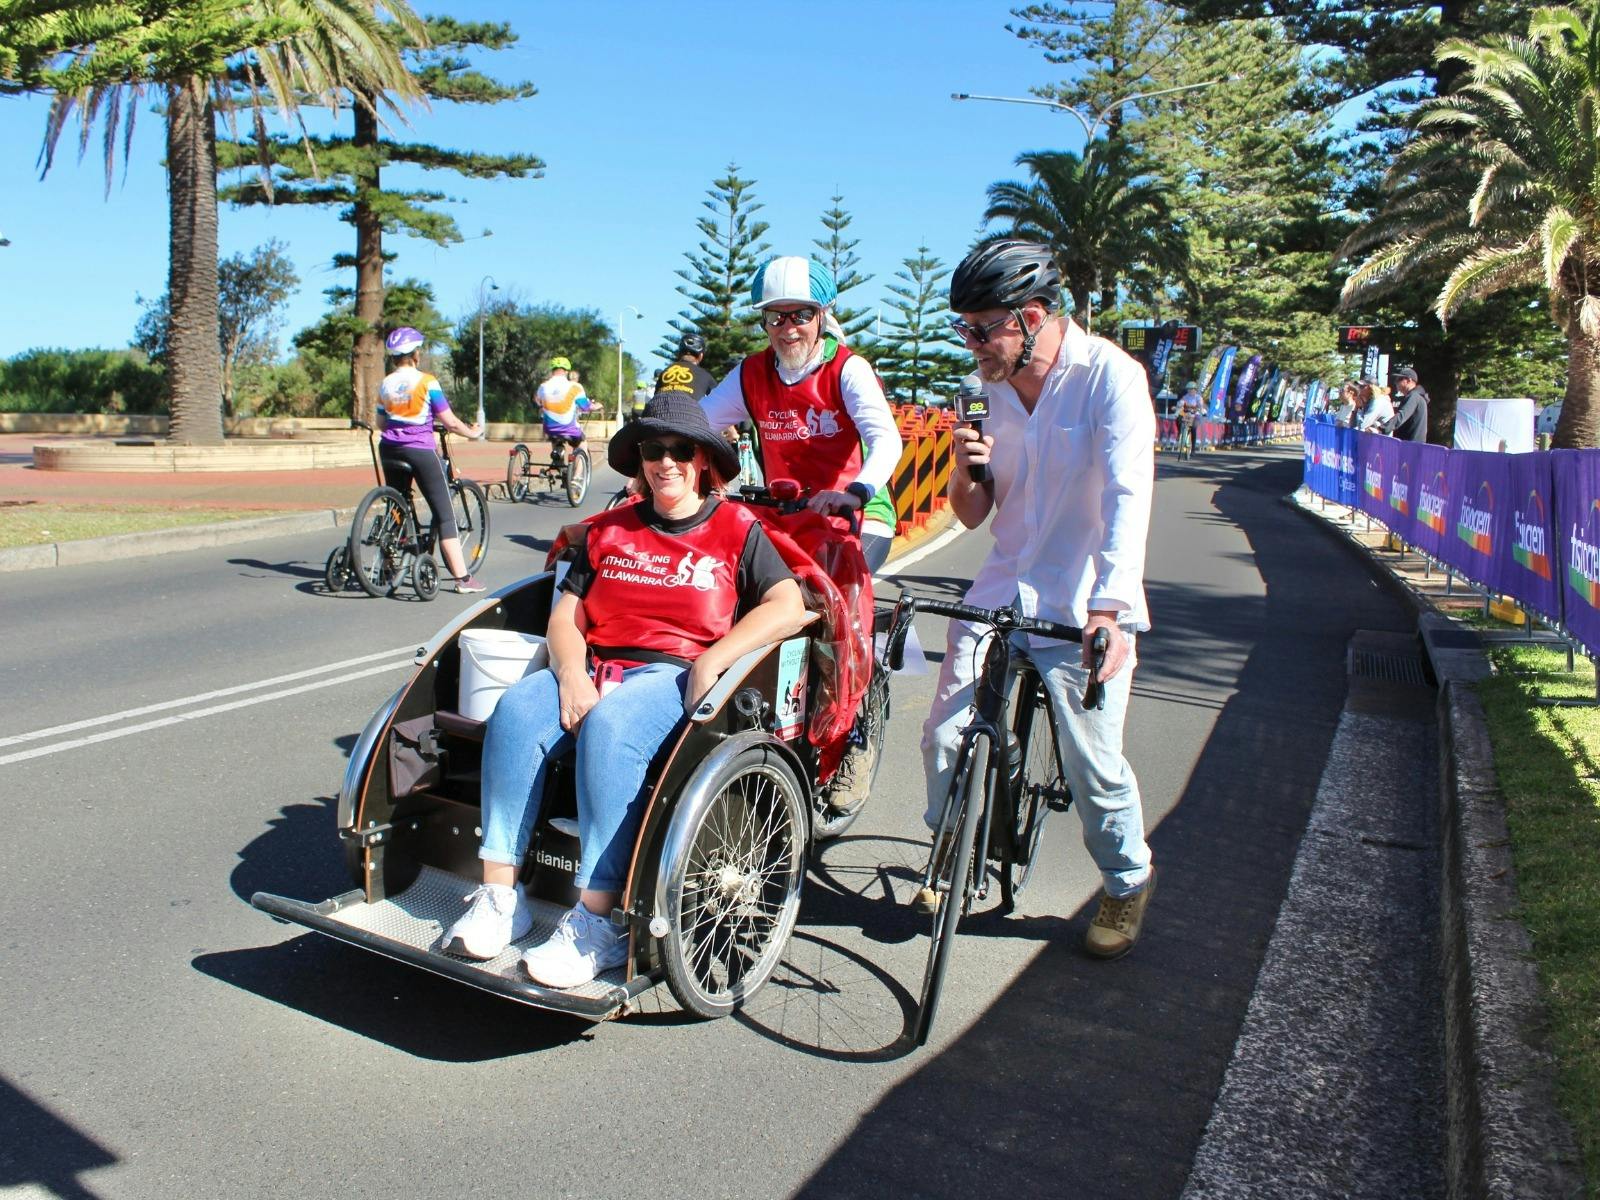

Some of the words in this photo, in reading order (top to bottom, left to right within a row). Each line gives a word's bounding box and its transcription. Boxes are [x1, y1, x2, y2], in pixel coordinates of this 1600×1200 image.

[602, 569, 662, 586] ILLAWARRA
[643, 564, 668, 575] AGE
[531, 850, 573, 873] tiania
